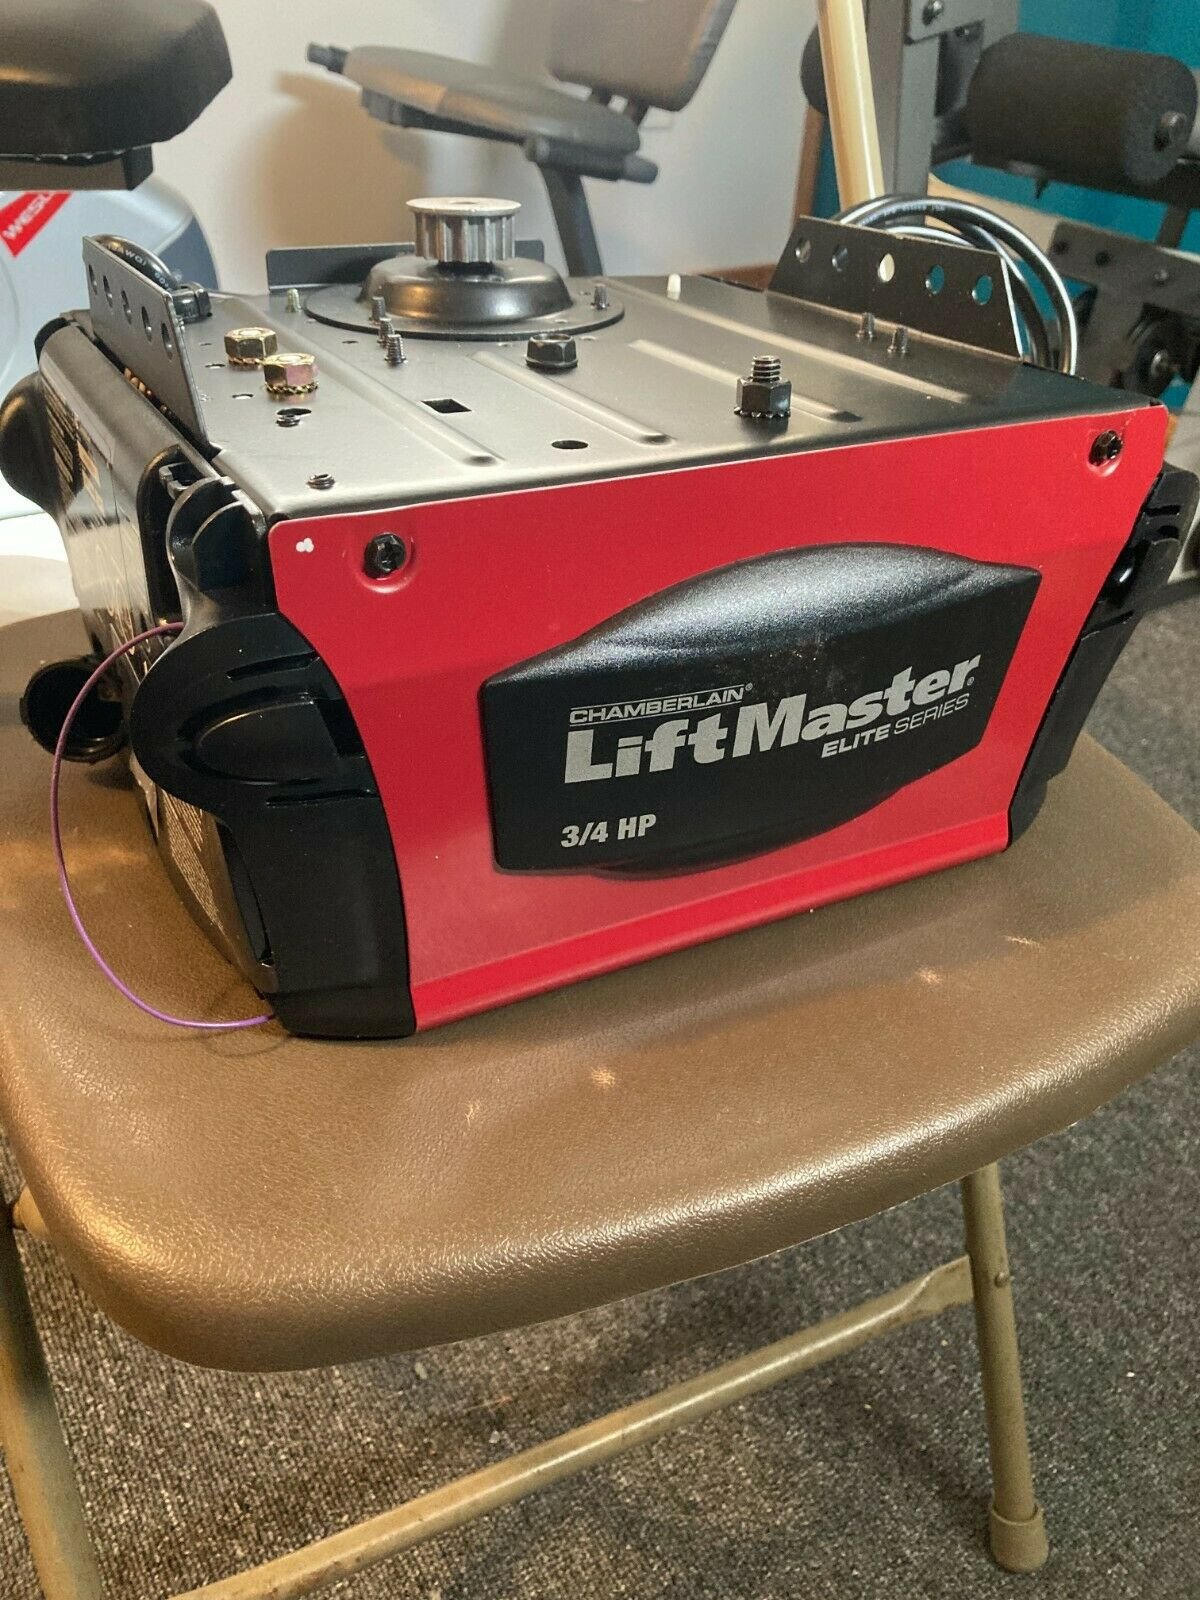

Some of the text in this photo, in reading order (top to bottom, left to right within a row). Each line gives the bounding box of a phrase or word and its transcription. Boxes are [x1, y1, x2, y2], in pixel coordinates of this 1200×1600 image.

[564, 654, 982, 784] LiftMaster
[569, 687, 745, 724] CHAMBERLAIN
[821, 693, 970, 758] ELITE SERIES
[560, 813, 657, 848] 3/4 HP
